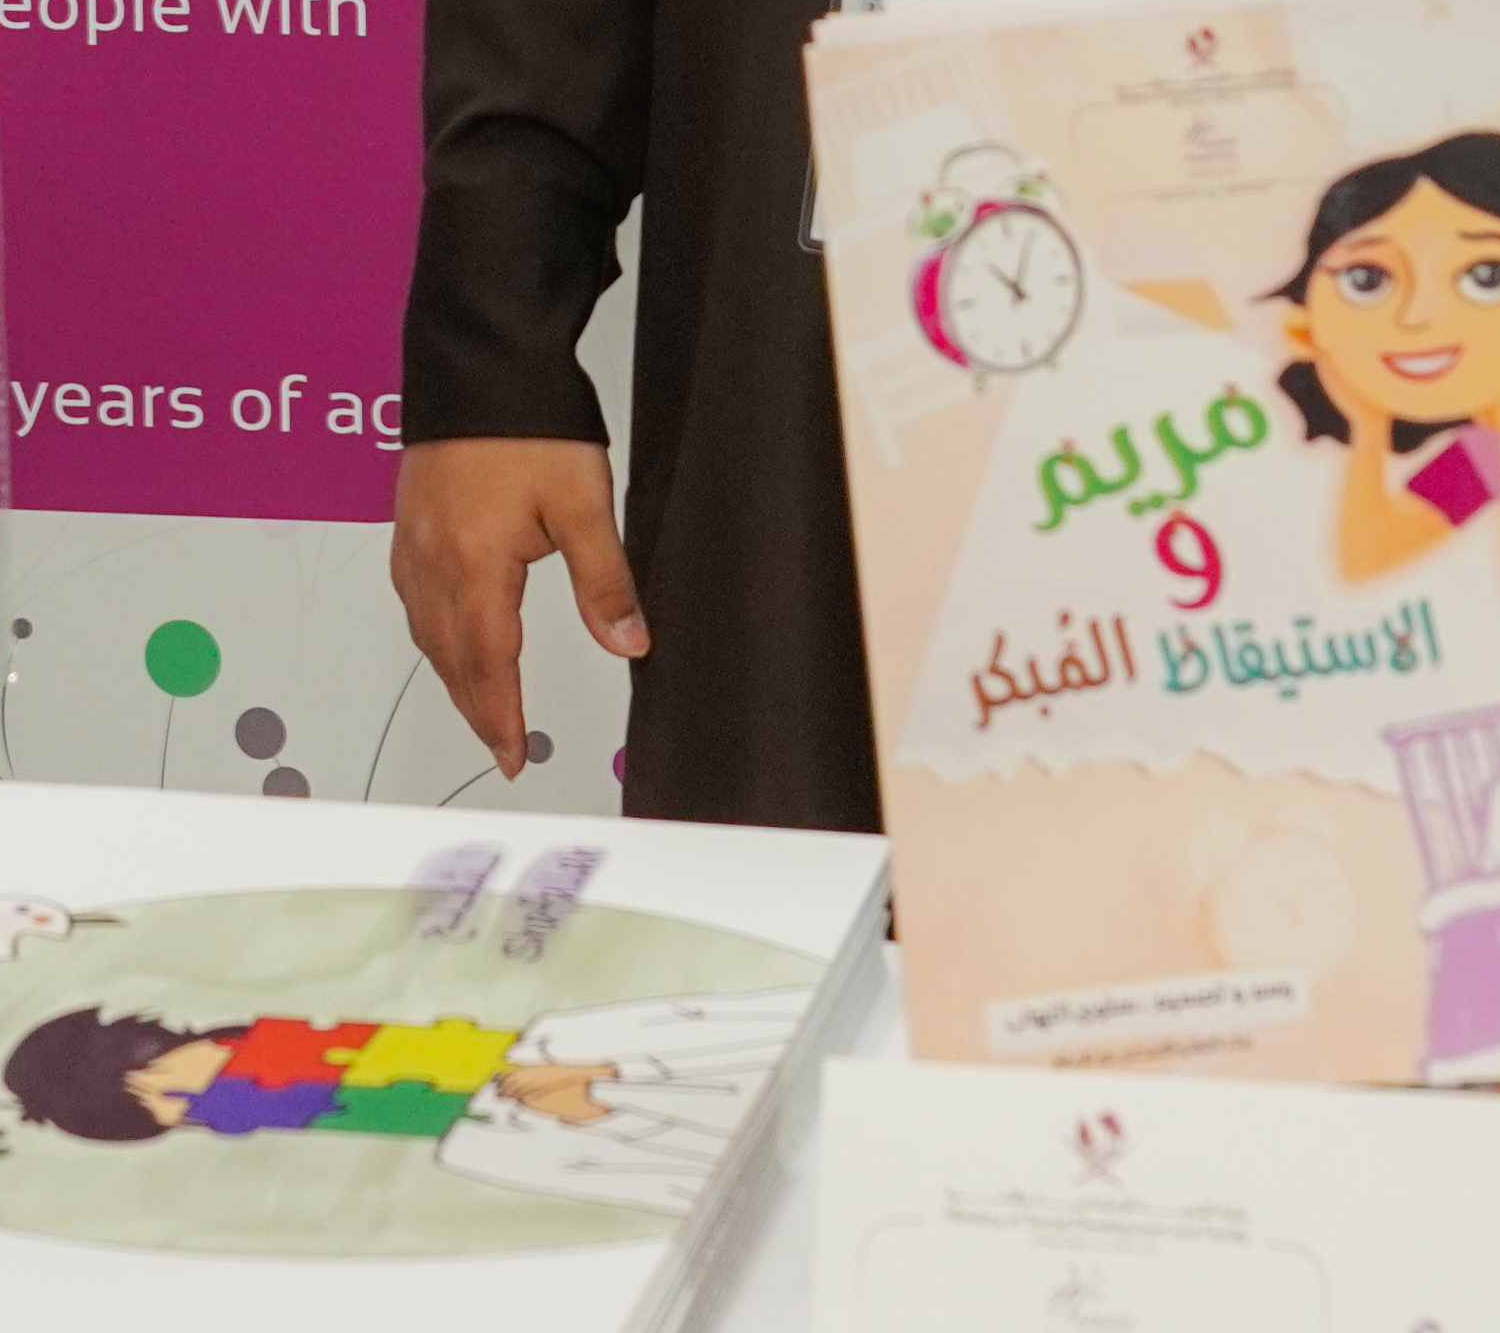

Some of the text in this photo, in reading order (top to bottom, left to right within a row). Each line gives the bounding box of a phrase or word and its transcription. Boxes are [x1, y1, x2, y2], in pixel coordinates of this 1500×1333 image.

[11, 374, 404, 450] years of ag
